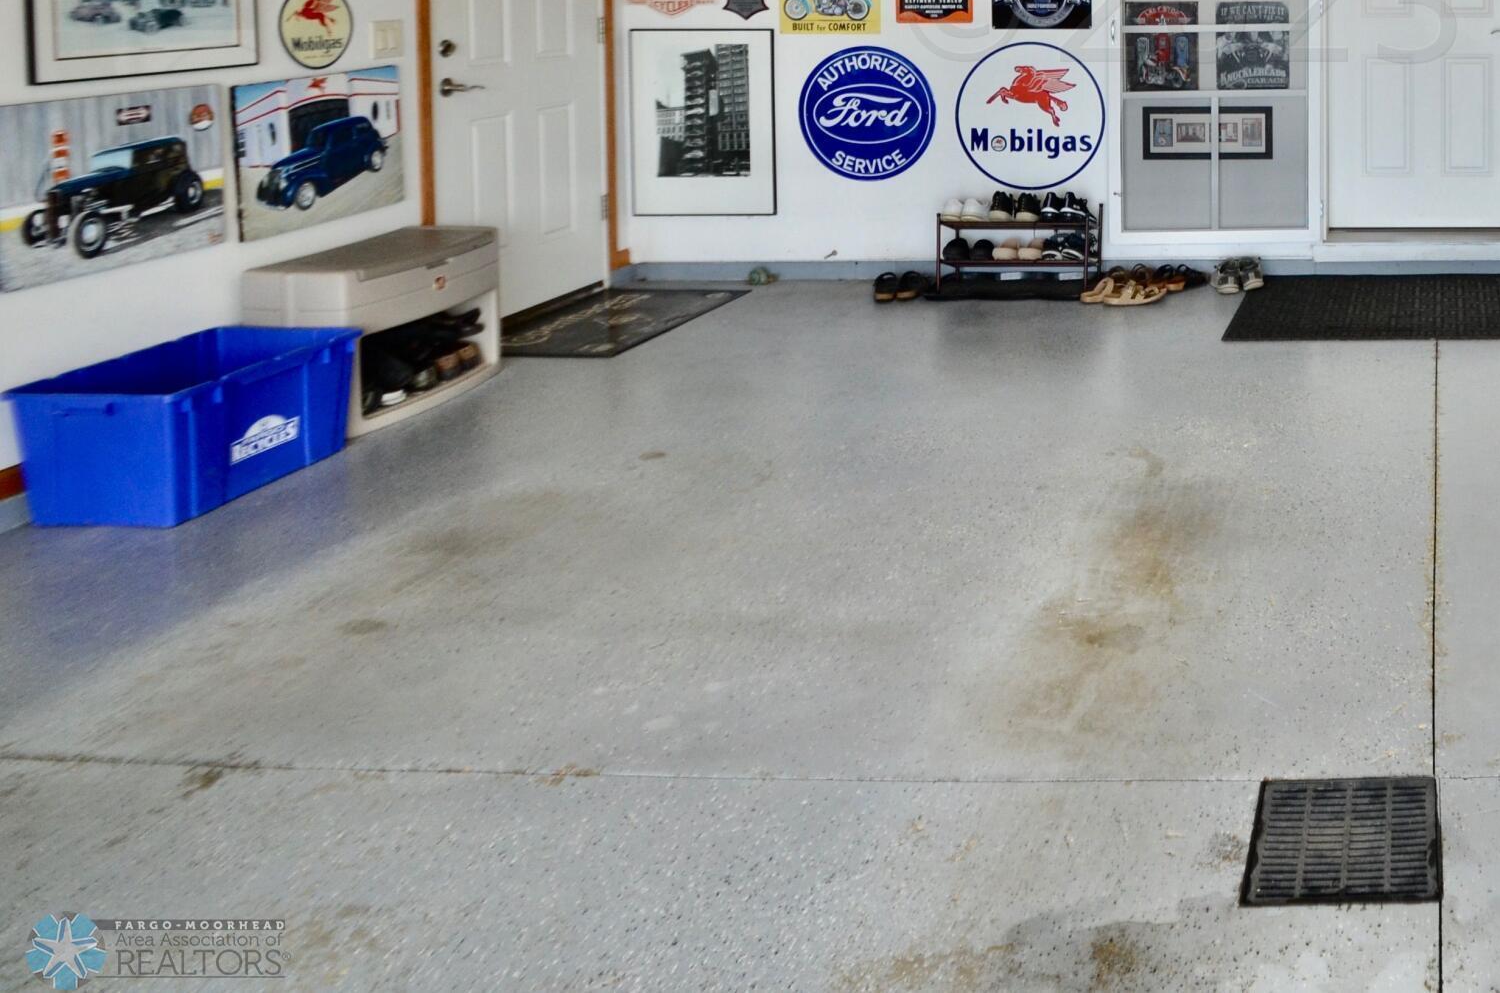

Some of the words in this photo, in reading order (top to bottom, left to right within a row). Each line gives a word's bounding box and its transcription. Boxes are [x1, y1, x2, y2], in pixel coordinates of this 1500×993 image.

[1220, 7, 1228, 16] IF
[1230, 6, 1242, 16] WE
[1277, 7, 1285, 17] IT
[792, 22, 814, 32] BUILT
[828, 22, 867, 32] COMFORT
[291, 36, 343, 54] Mobilgas
[815, 52, 916, 92] AUTHORIZED
[818, 91, 913, 128] Ford
[970, 127, 1093, 160] Mobilgas
[831, 150, 907, 175] SERVICE
